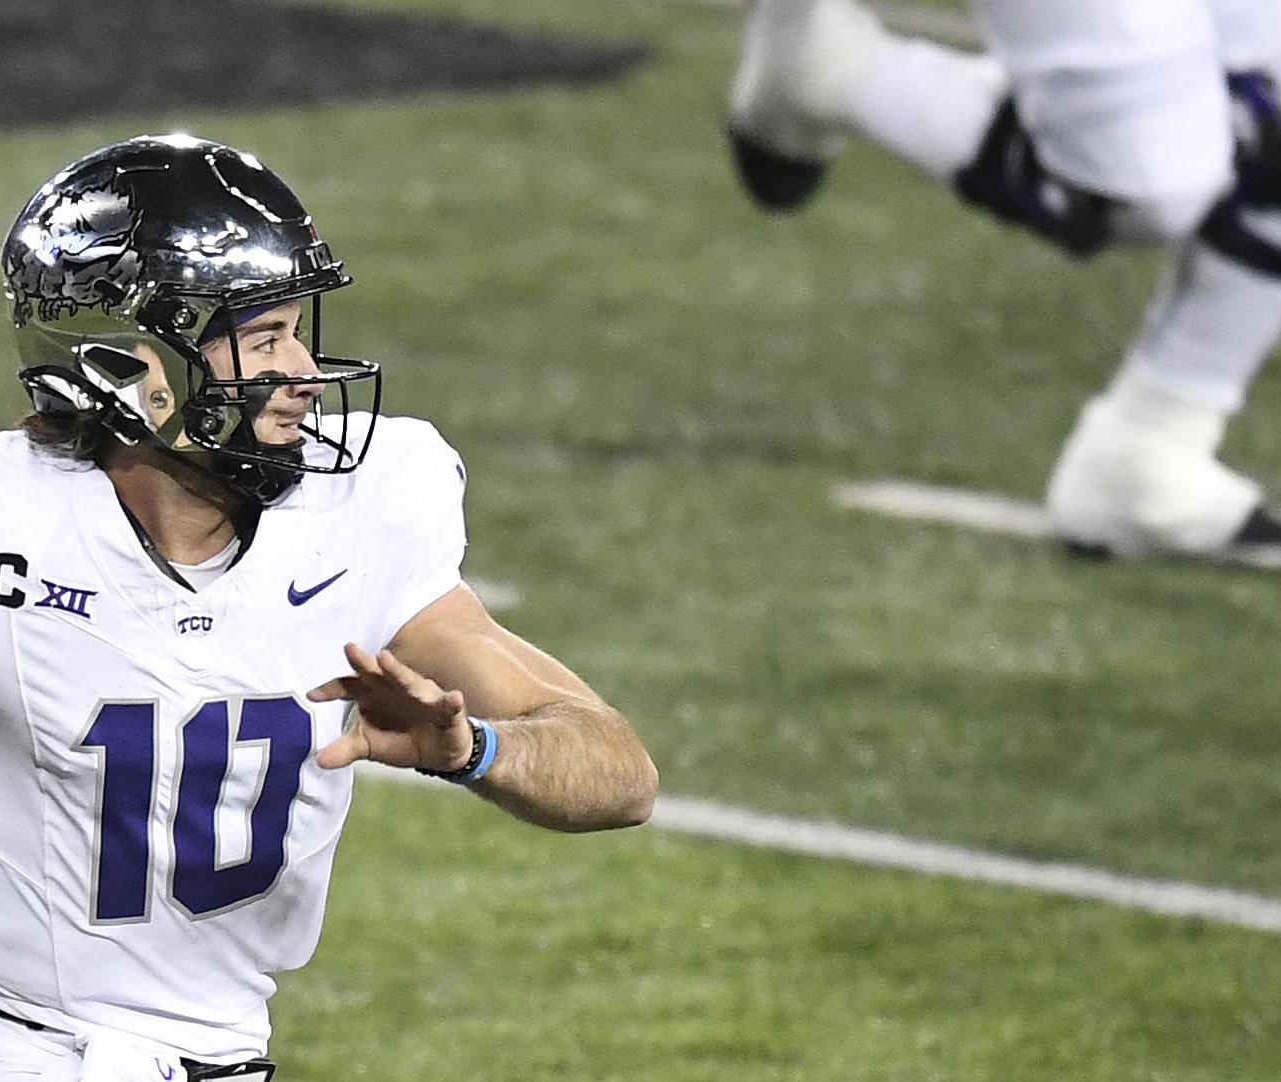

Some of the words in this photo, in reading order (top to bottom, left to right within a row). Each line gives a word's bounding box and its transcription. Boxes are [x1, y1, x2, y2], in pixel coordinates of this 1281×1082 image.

[34, 578, 98, 619] XII
[177, 615, 214, 634] TCU
[69, 691, 317, 926] 10
